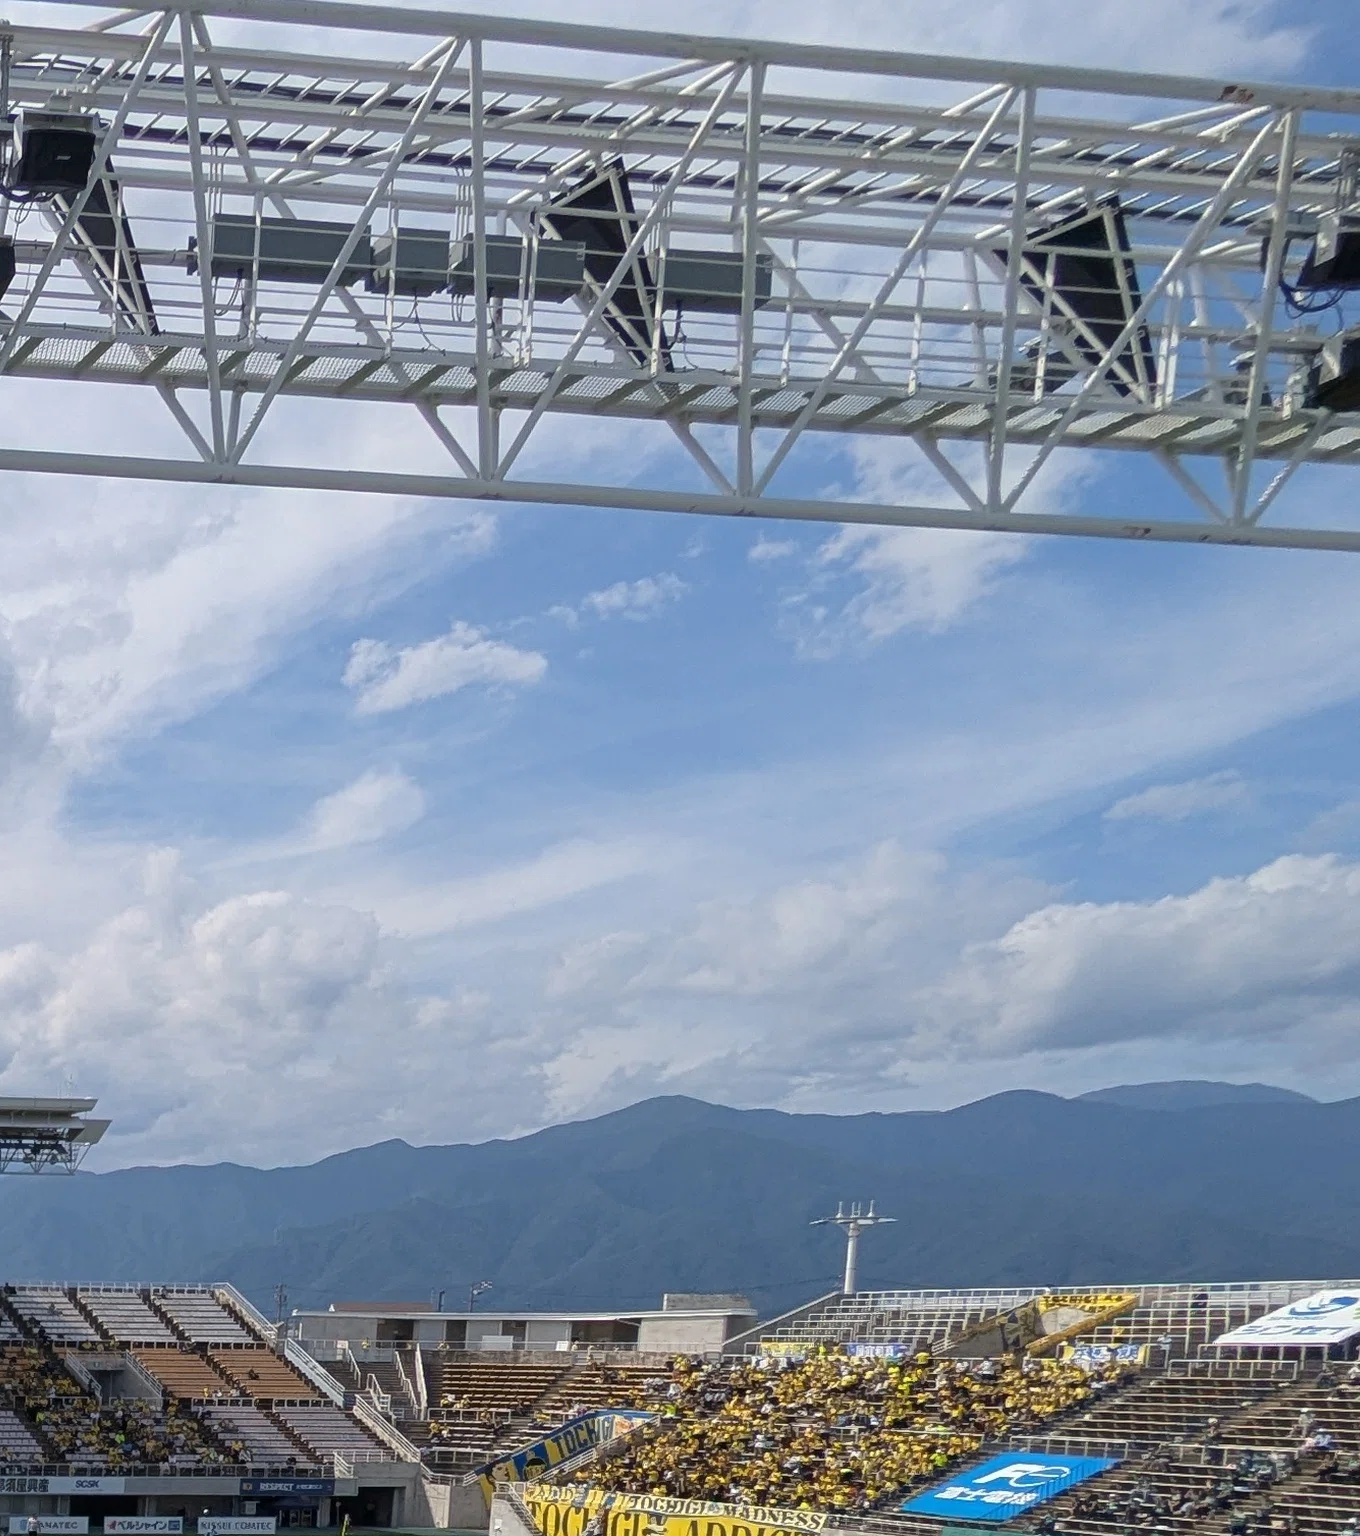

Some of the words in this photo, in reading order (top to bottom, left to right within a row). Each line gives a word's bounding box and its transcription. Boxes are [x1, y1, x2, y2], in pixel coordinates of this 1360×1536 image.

[74, 1479, 100, 1488] SCSK
[631, 1495, 707, 1514] TOCHIGI
[723, 1505, 826, 1531] MADNESS
[36, 1521, 78, 1530] ANATEC
[117, 1520, 168, 1531] ベルシャイン
